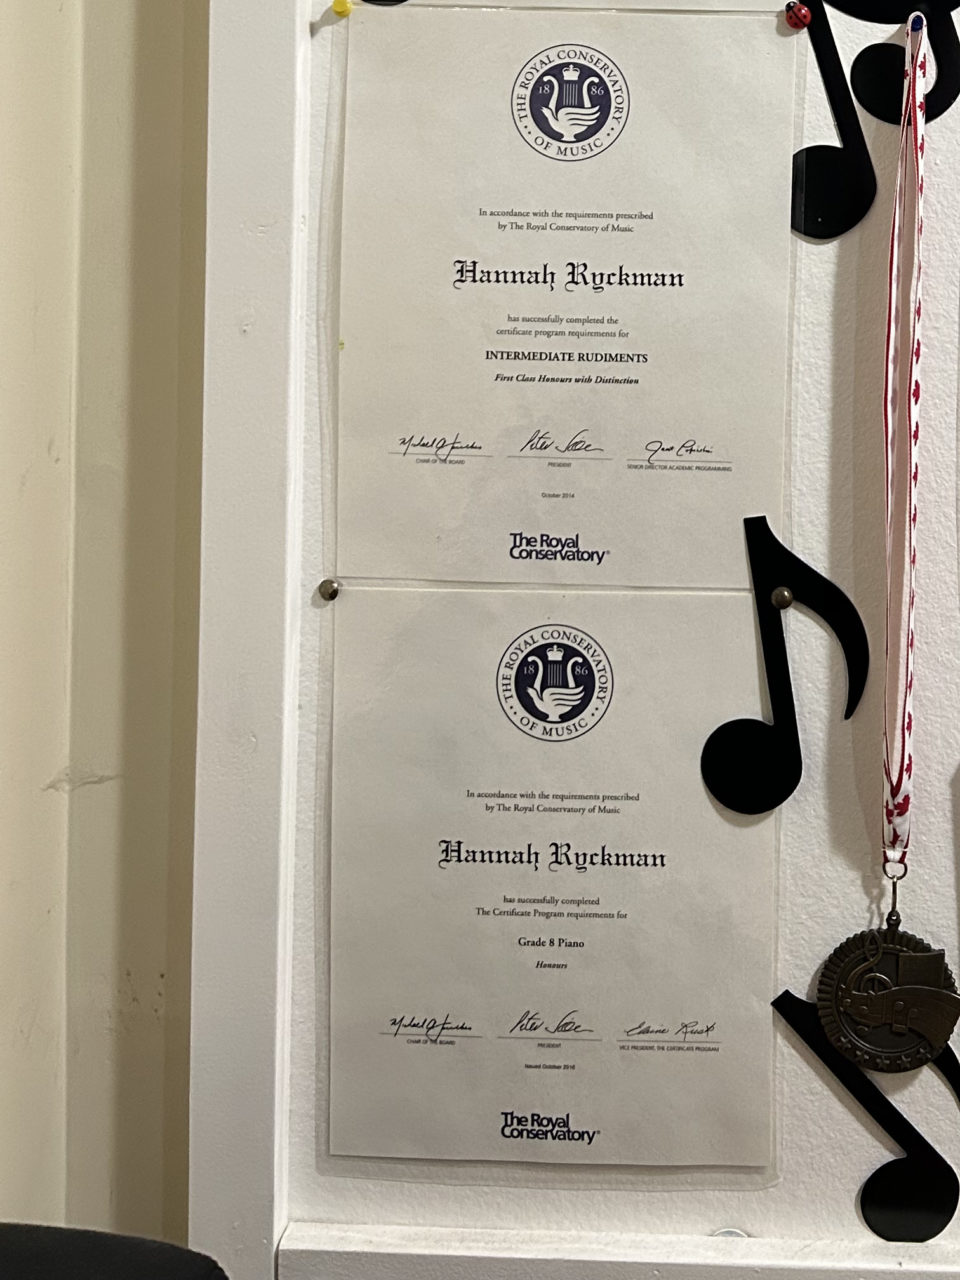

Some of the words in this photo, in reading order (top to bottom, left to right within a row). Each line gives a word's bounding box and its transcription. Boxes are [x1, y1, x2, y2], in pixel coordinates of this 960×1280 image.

[453, 259, 556, 292] Hannah
[564, 261, 684, 294] Ryckman
[485, 350, 575, 362] INTERMEDIATE
[577, 352, 648, 364] RUDIMENTS
[494, 373, 514, 382] First
[515, 373, 536, 383] Class
[537, 374, 573, 384] Honours
[574, 374, 593, 384] with
[594, 375, 639, 385] Distinction
[509, 531, 538, 548] The
[540, 532, 579, 551] Royal
[509, 546, 606, 566] Conservatory
[503, 634, 539, 671] ROYAL
[523, 665, 535, 675] 18
[540, 629, 609, 705] CONSERVATORY
[574, 665, 589, 676] 86
[501, 673, 514, 703] THE
[519, 716, 539, 732] OF
[541, 717, 589, 737] MUSIC
[438, 839, 540, 872] Hannah
[548, 841, 666, 874] Ryckman
[503, 894, 516, 904] has
[517, 895, 560, 908] successfully
[560, 896, 600, 908] completed
[475, 906, 491, 917] The
[492, 907, 532, 918] Certificate
[533, 908, 565, 921] Program
[566, 909, 615, 921] requirements
[616, 910, 628, 920] for
[517, 936, 547, 948] Grade
[548, 937, 555, 948] 8
[557, 937, 585, 949] Piano
[534, 960, 569, 970] Honours
[500, 1111, 529, 1127] The
[530, 1112, 570, 1131] Royal
[500, 1124, 596, 1146] Conservatory
